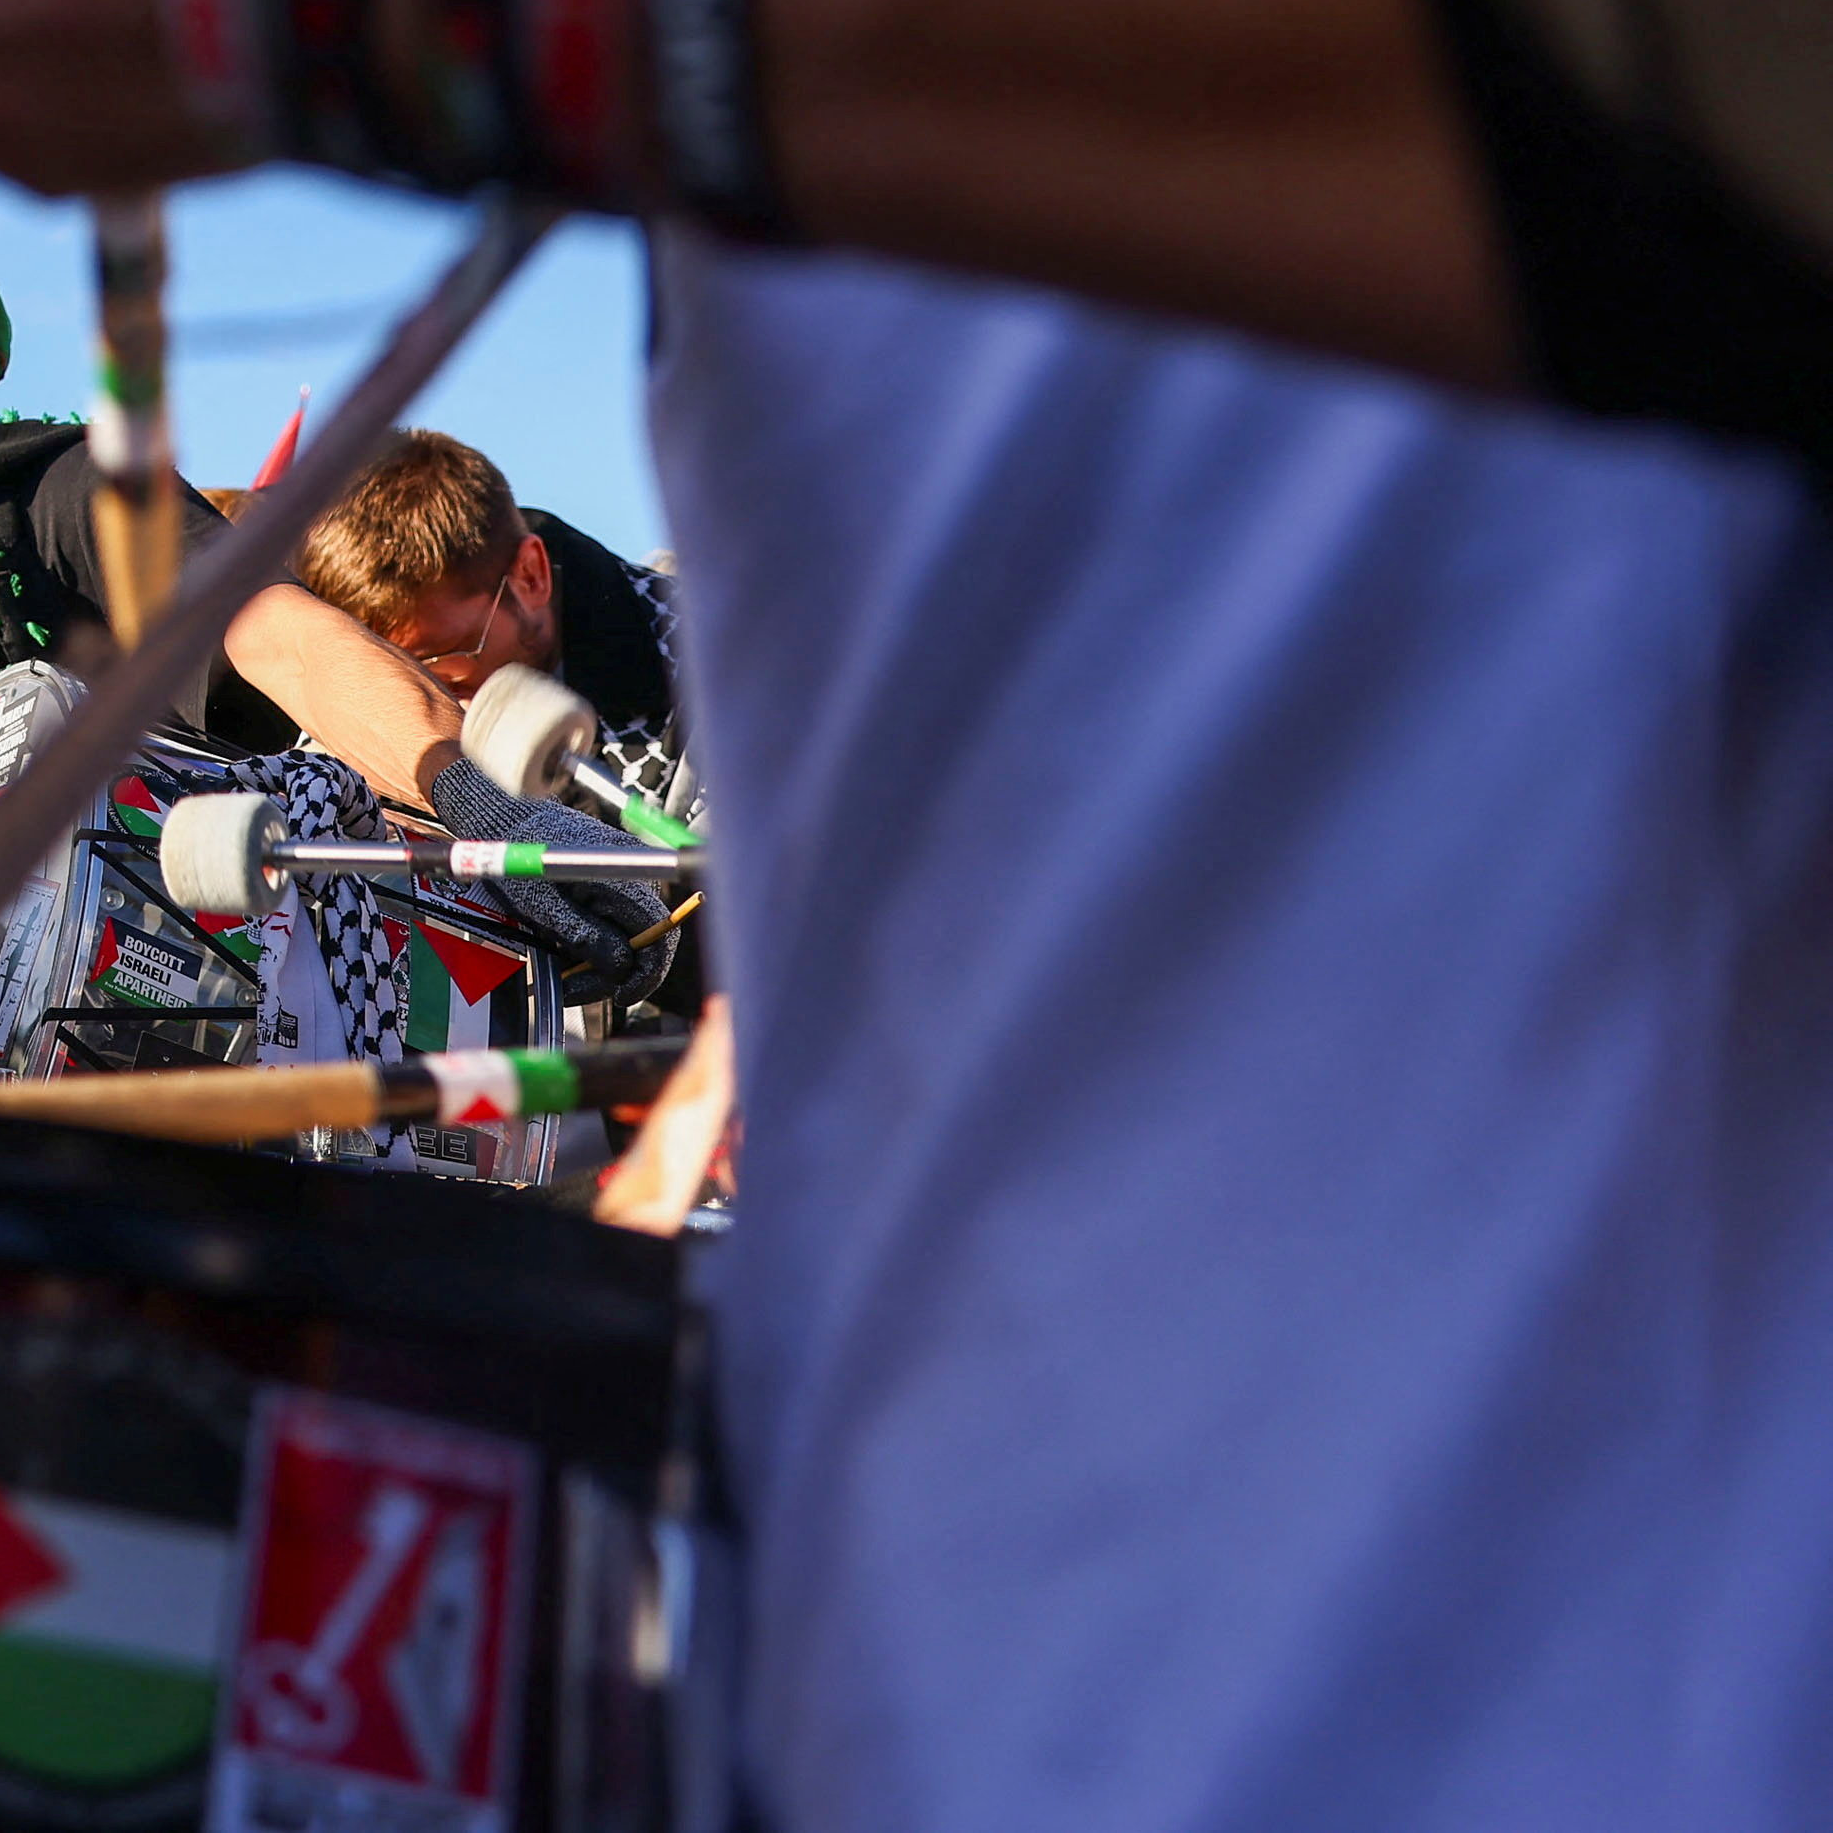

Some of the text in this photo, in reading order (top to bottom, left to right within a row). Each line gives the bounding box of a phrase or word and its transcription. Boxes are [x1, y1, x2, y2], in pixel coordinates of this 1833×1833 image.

[119, 952, 172, 986] ISRAELI
[124, 934, 185, 972] BOYCOTT
[113, 971, 188, 1008] APARTHEID
